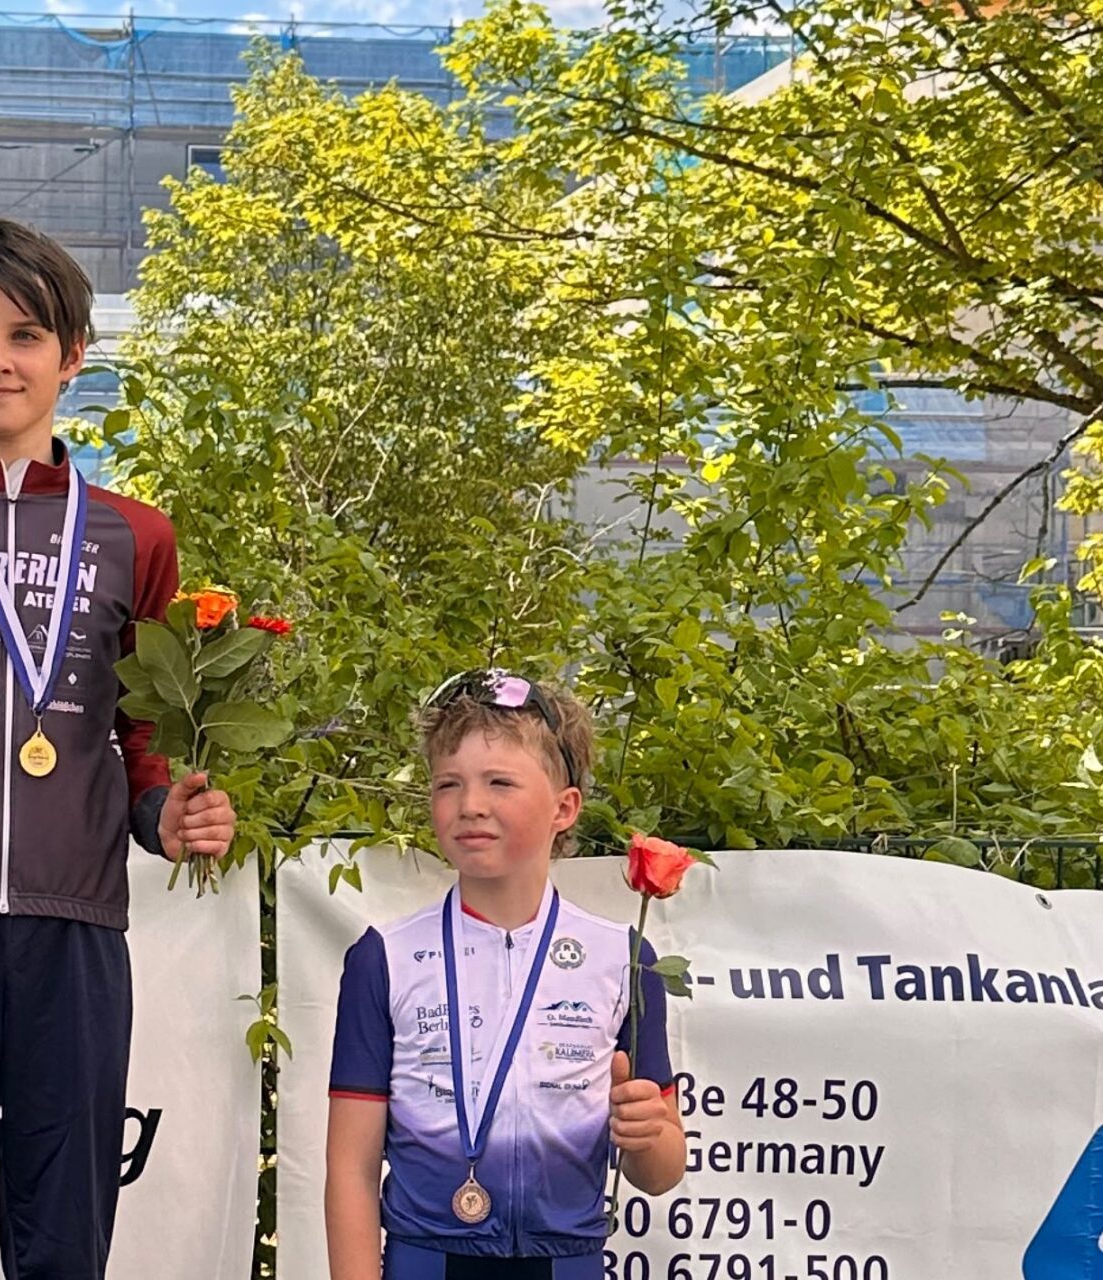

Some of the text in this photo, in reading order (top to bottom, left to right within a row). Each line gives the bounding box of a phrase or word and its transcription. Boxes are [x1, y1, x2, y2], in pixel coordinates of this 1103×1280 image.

[23, 590, 91, 613] ATEER
[729, 954, 845, 1000] und
[418, 1020, 449, 1035] Berli
[741, 1077, 878, 1121] 48-50
[668, 1197, 831, 1240] 6791-0
